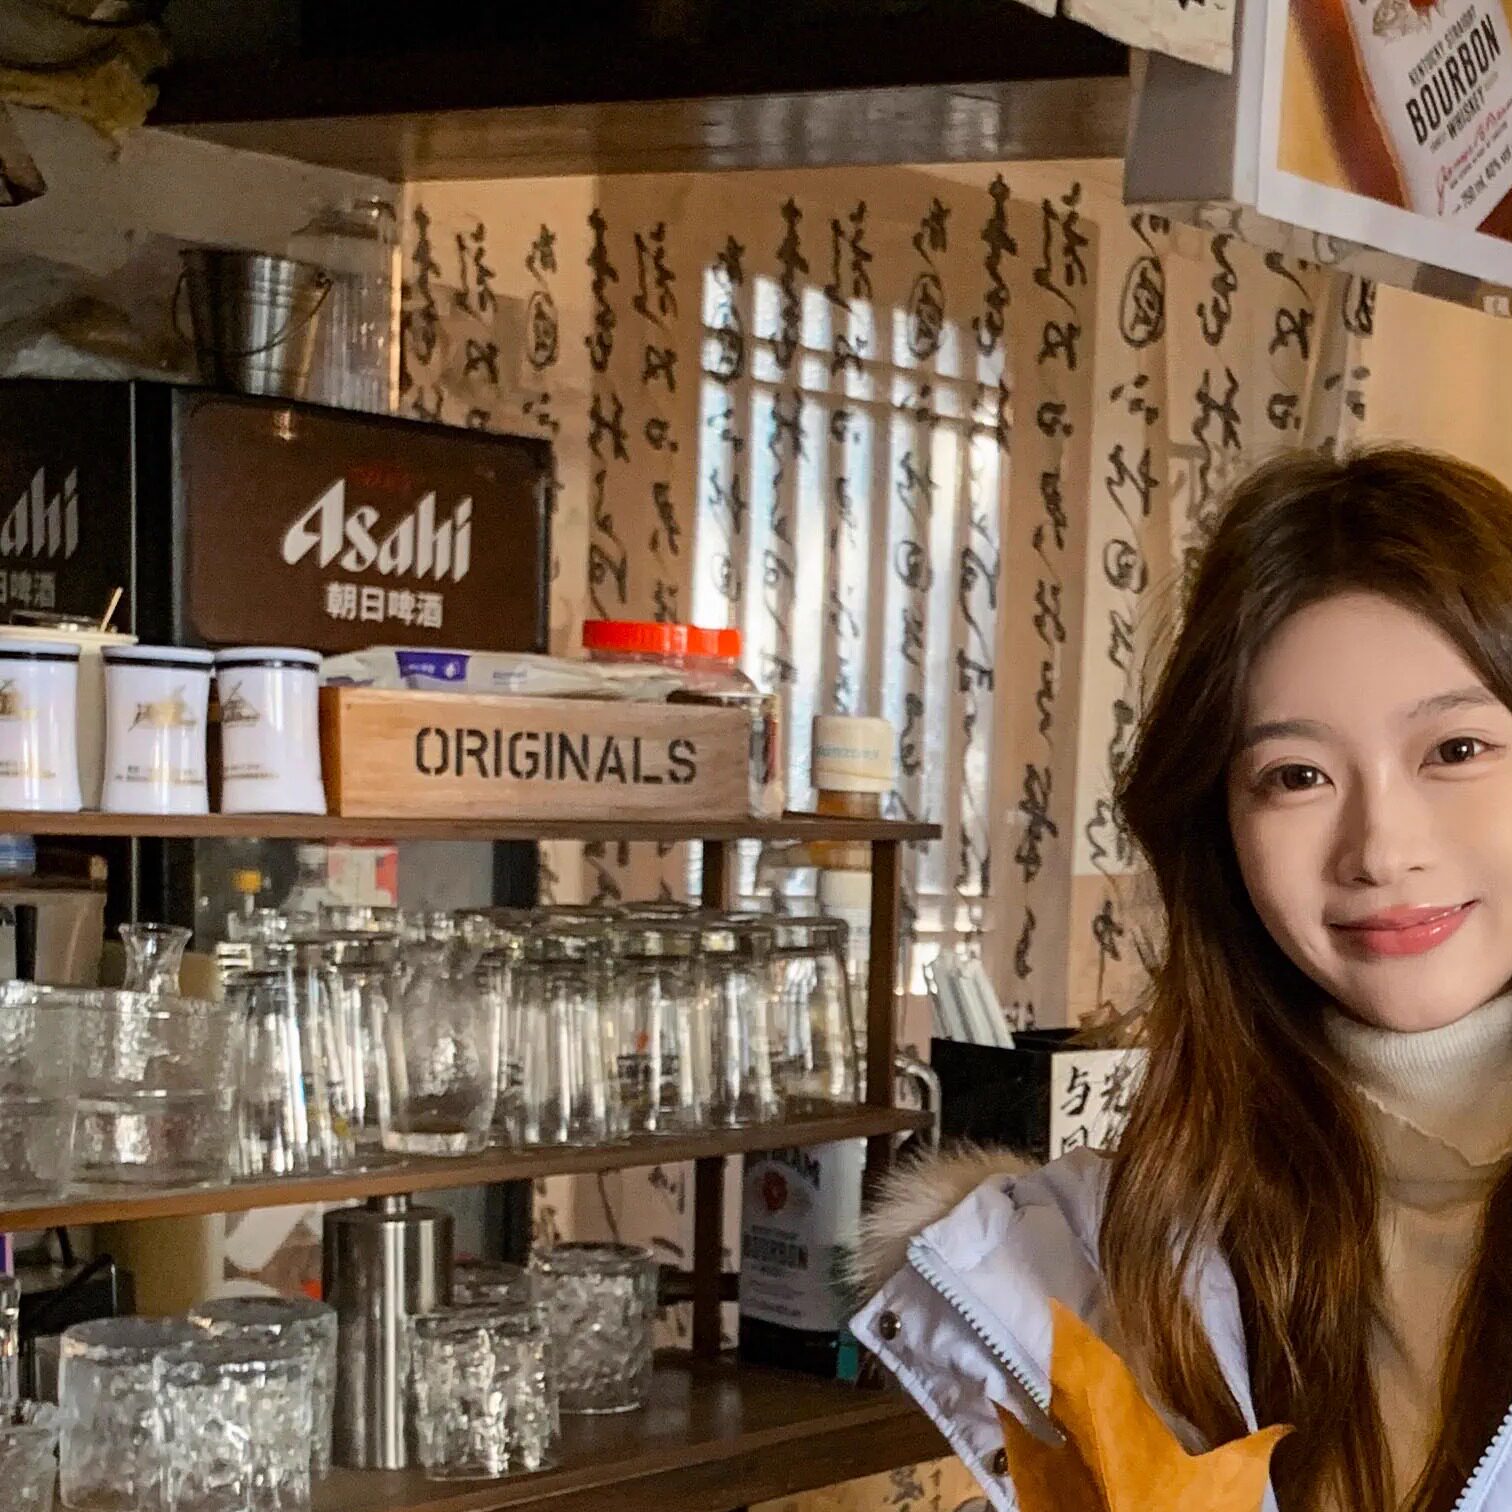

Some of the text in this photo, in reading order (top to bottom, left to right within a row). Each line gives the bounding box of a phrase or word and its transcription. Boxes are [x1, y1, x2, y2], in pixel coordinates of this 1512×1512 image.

[1405, 14, 1501, 146] BOURBON
[281, 477, 473, 583] Asahi
[325, 582, 444, 630] 朝日啤酒
[415, 726, 698, 785] ORIGINALS
